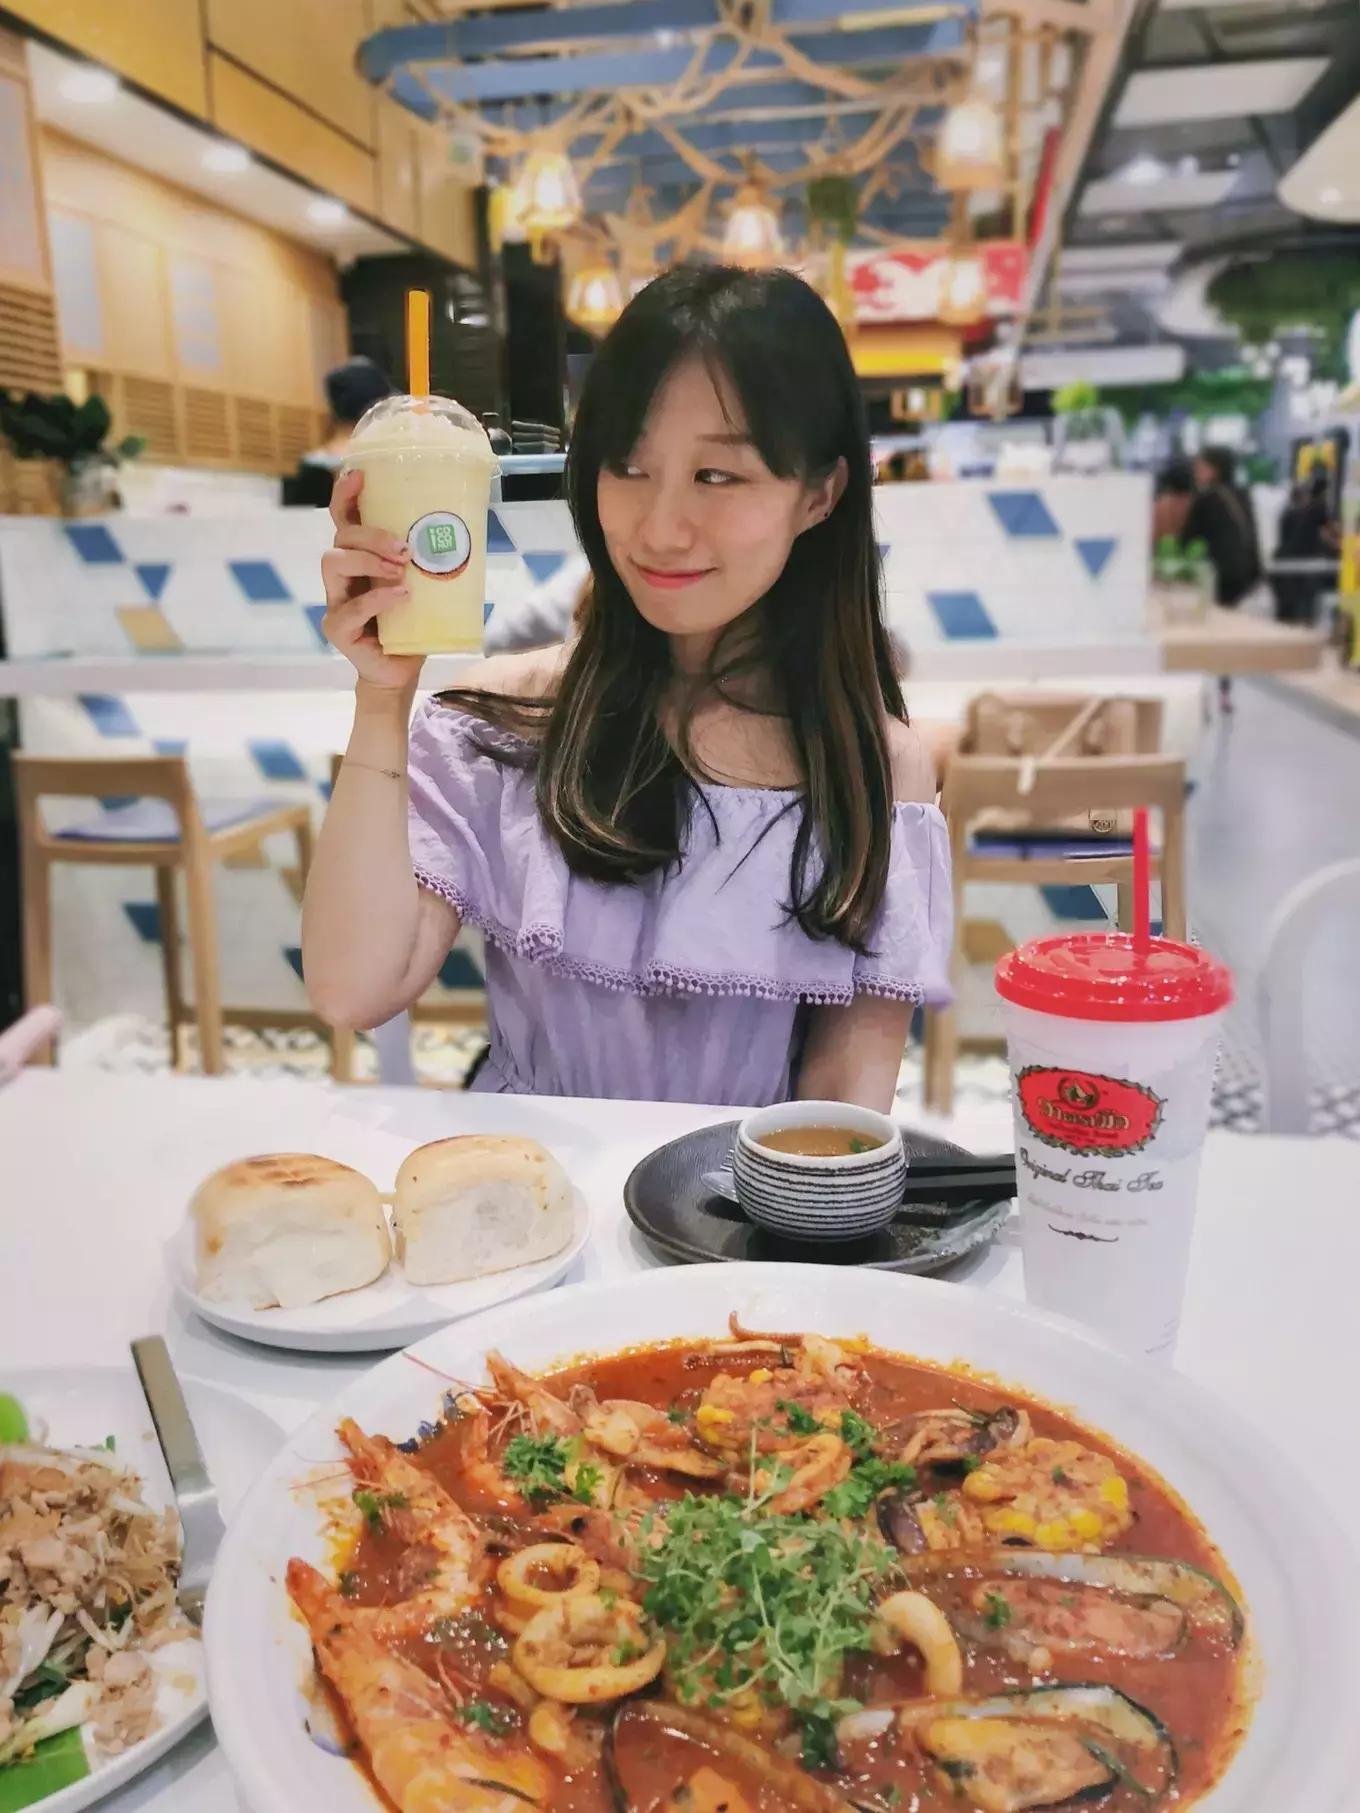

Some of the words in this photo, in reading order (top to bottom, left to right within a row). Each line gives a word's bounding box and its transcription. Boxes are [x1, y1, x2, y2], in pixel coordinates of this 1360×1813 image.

[1019, 1146, 1072, 1183] Original
[1072, 1169, 1121, 1192] Thai
[1126, 1168, 1164, 1192] Tea
